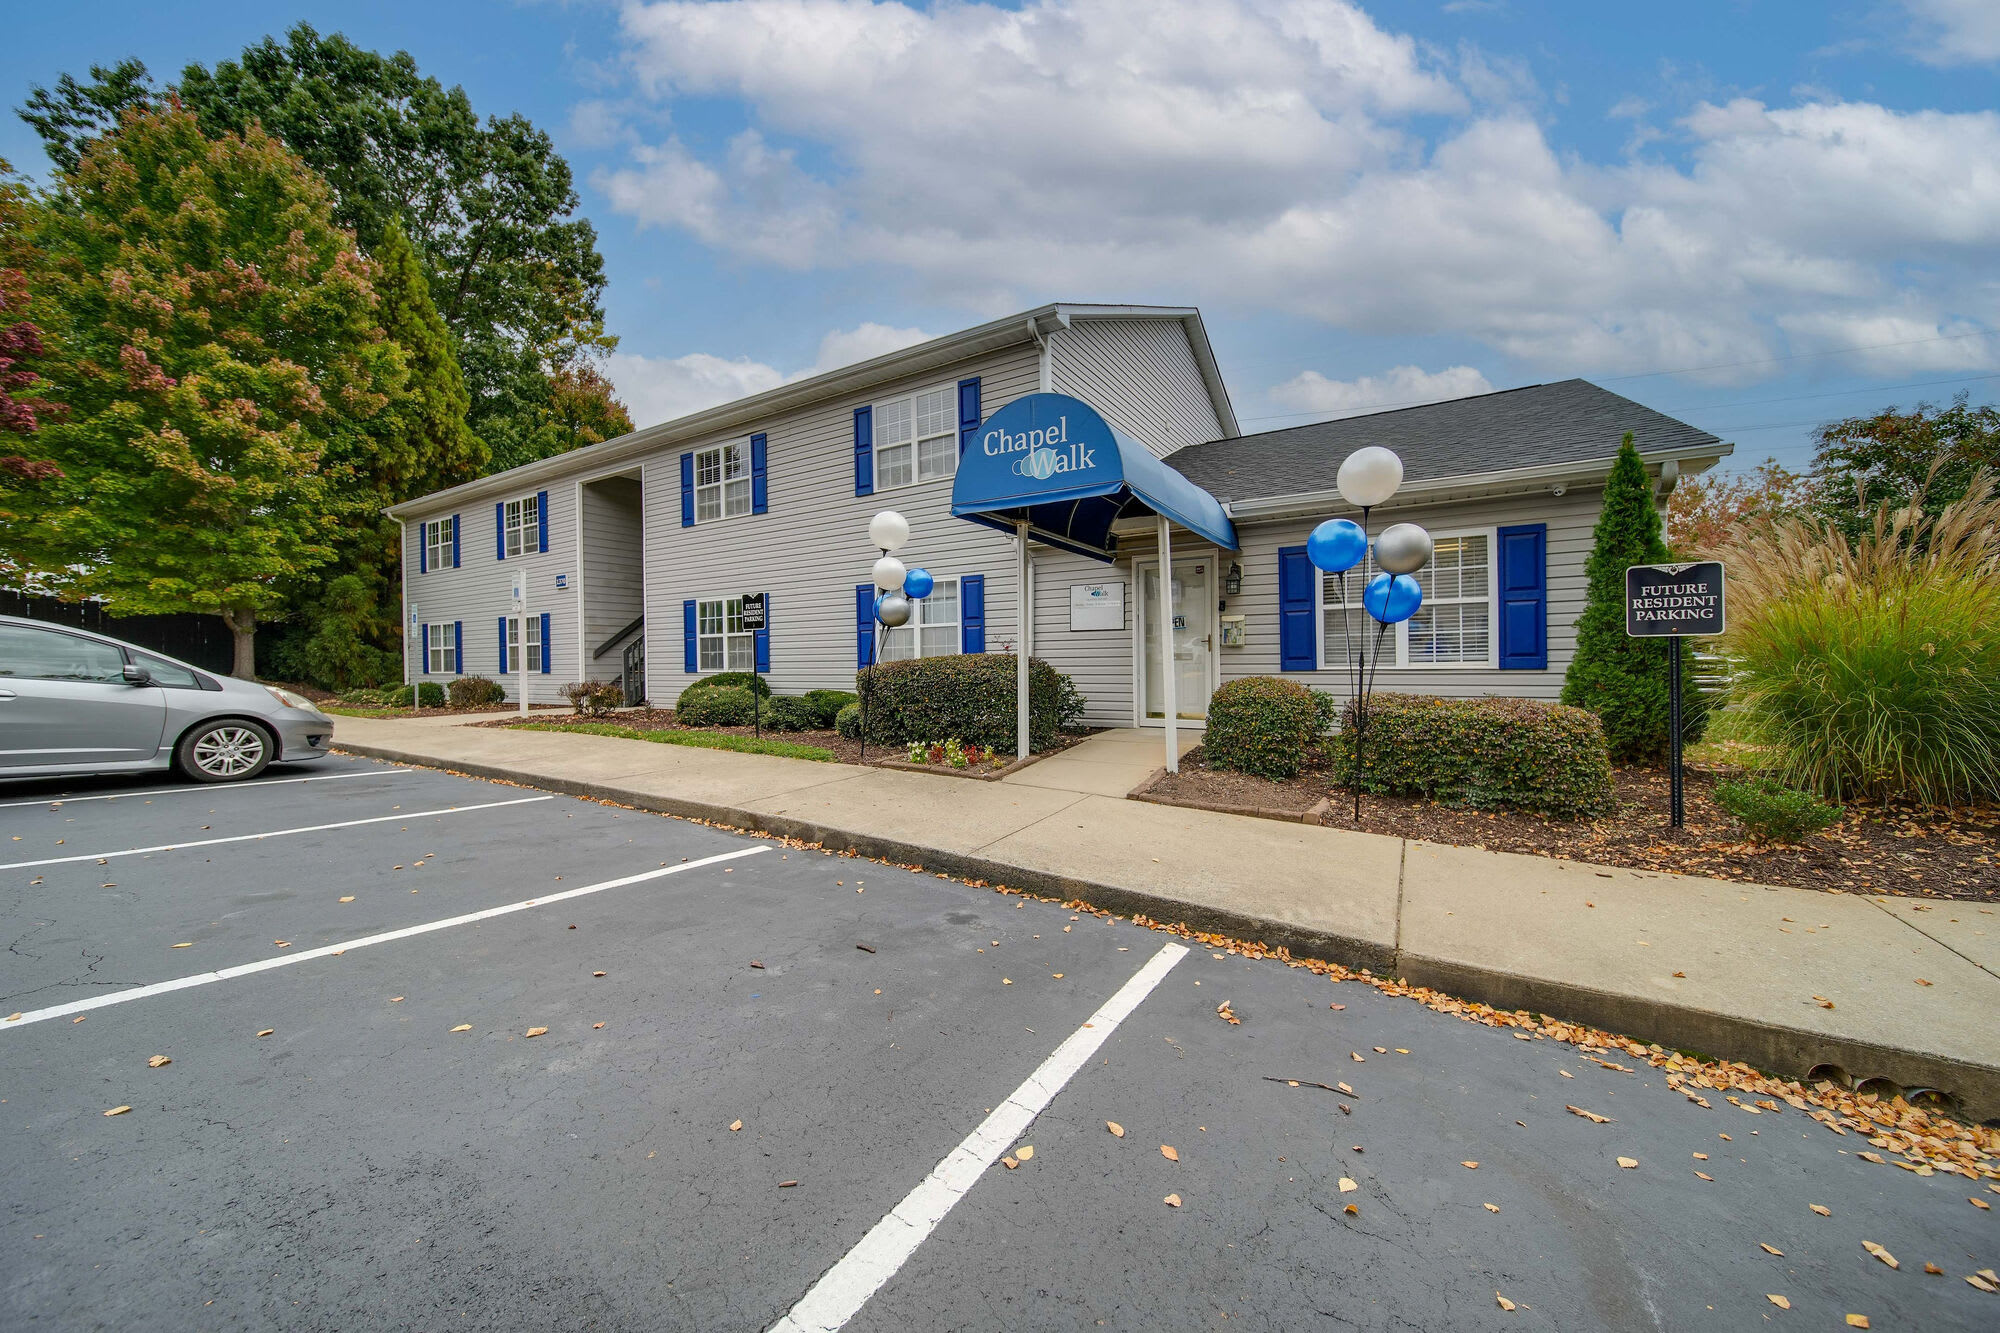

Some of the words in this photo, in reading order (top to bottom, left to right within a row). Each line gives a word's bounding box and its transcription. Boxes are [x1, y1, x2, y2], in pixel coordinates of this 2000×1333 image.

[984, 416, 1068, 456] Chapel
[1029, 443, 1096, 477] Walk
[1641, 583, 1708, 596] FUTURE
[1632, 595, 1718, 609] RESIDENT
[1635, 608, 1714, 621] PARKING
